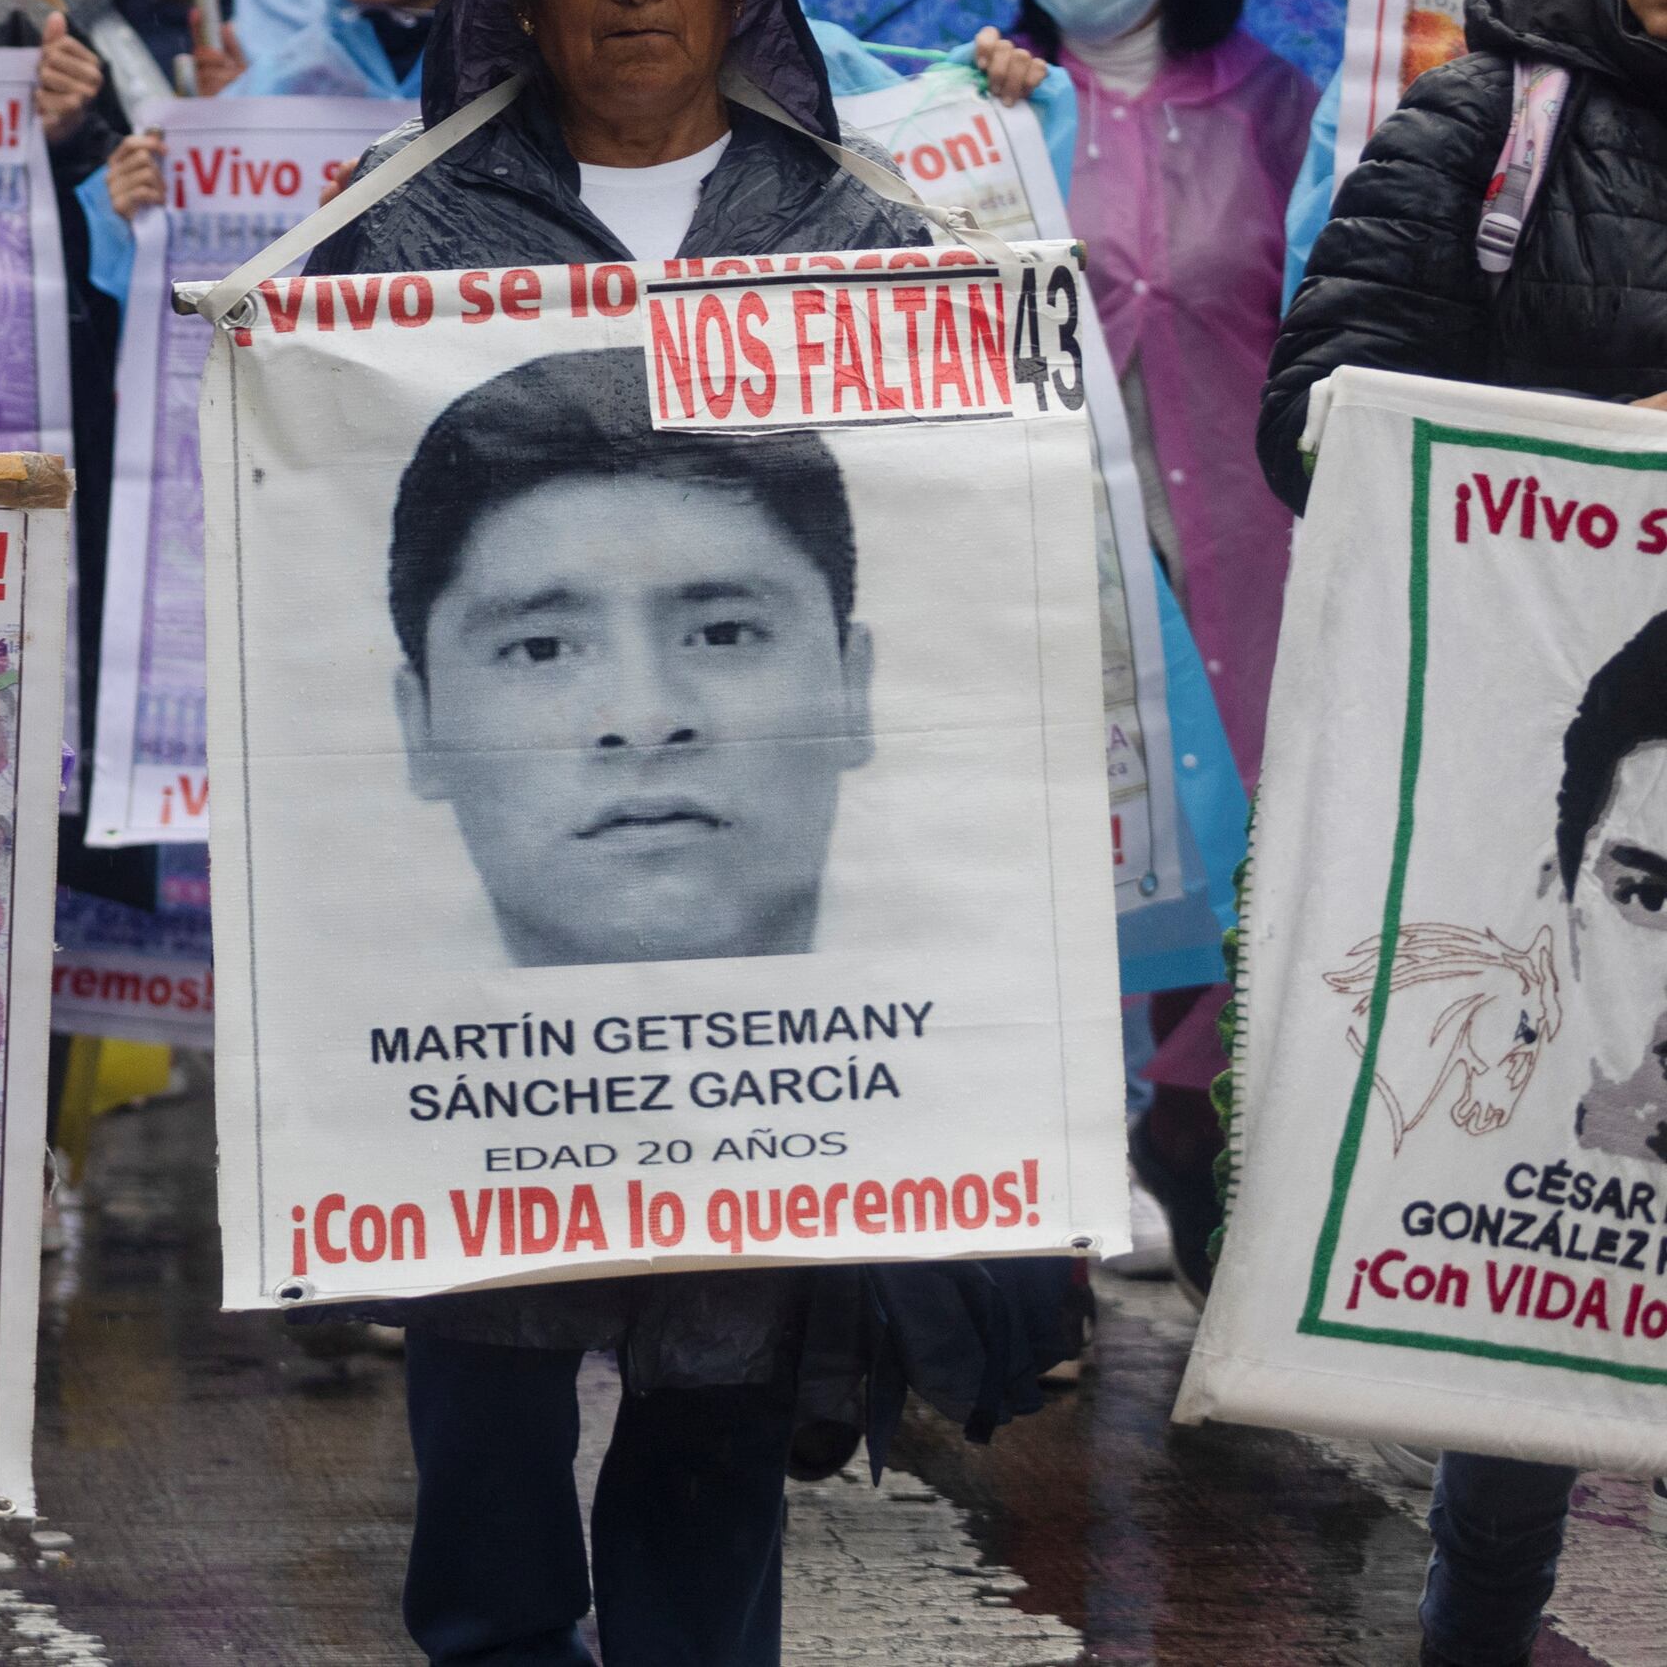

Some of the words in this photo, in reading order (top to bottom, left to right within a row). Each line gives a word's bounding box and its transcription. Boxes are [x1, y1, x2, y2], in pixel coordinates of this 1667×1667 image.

[174, 147, 302, 209] ¡Vivo
[235, 274, 434, 347] Vivo
[459, 268, 542, 325] se
[569, 262, 637, 317] lo
[649, 290, 777, 419] NOS
[792, 282, 1013, 415] FALTAN
[1013, 265, 1085, 412] 43
[1455, 473, 1619, 549] ¡Vivo
[1637, 508, 1667, 555] s
[369, 1011, 577, 1065] MARTÍN
[593, 1000, 935, 1054] GETSEMANY
[408, 1073, 674, 1123] SÁNCHEZ
[688, 1056, 901, 1109] GARCÍA
[484, 1143, 618, 1173] EDAD
[635, 1138, 694, 1166] 20
[710, 1127, 849, 1163] AÑOS
[290, 1192, 427, 1277] ¡Con
[448, 1182, 608, 1259] VIDA
[628, 1179, 688, 1248] lo
[705, 1158, 1043, 1255] queremos!
[1504, 1158, 1656, 1225] CÉSAR
[1401, 1200, 1650, 1271] GONZÁLEZ
[1345, 1248, 1470, 1310] ¡Con
[1486, 1260, 1612, 1332] VIDA
